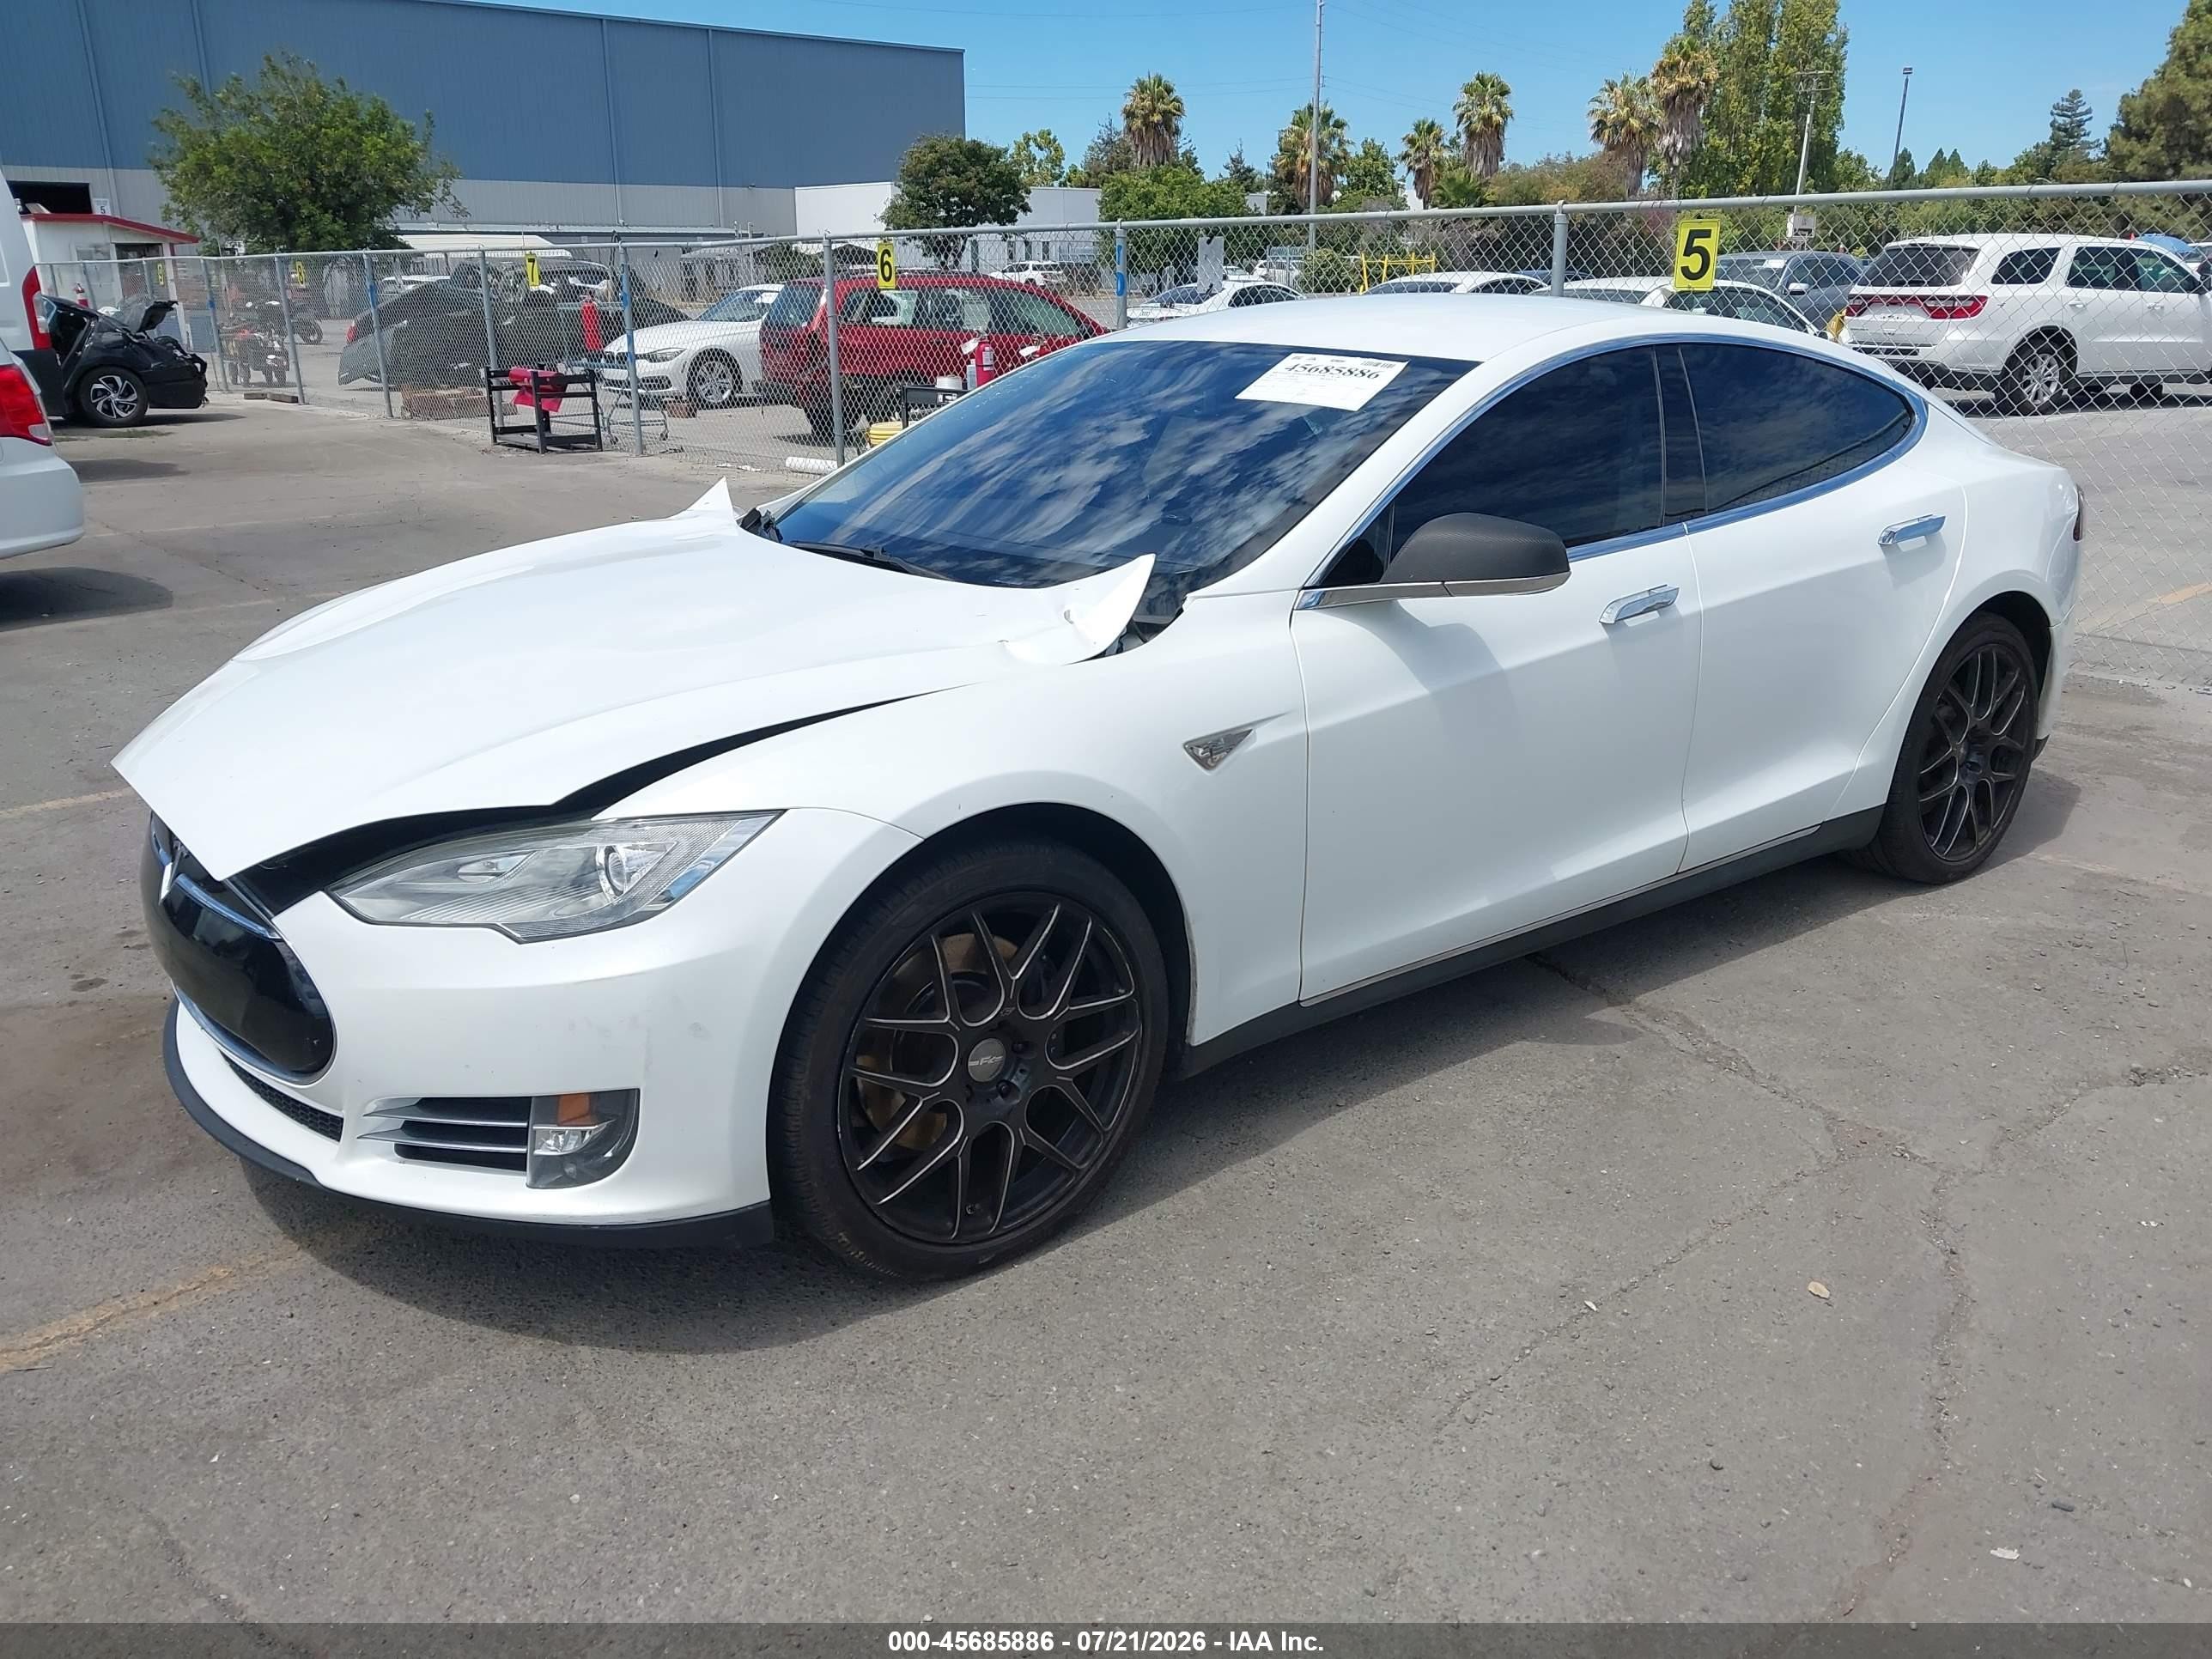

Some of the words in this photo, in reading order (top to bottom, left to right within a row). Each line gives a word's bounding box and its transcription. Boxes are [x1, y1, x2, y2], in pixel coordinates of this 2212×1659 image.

[100, 205, 106, 214] 5
[880, 248, 893, 283] 6
[1680, 228, 1712, 281] 5
[297, 264, 304, 284] 8
[527, 258, 536, 283] 7
[1285, 363, 1385, 379] 45685886
